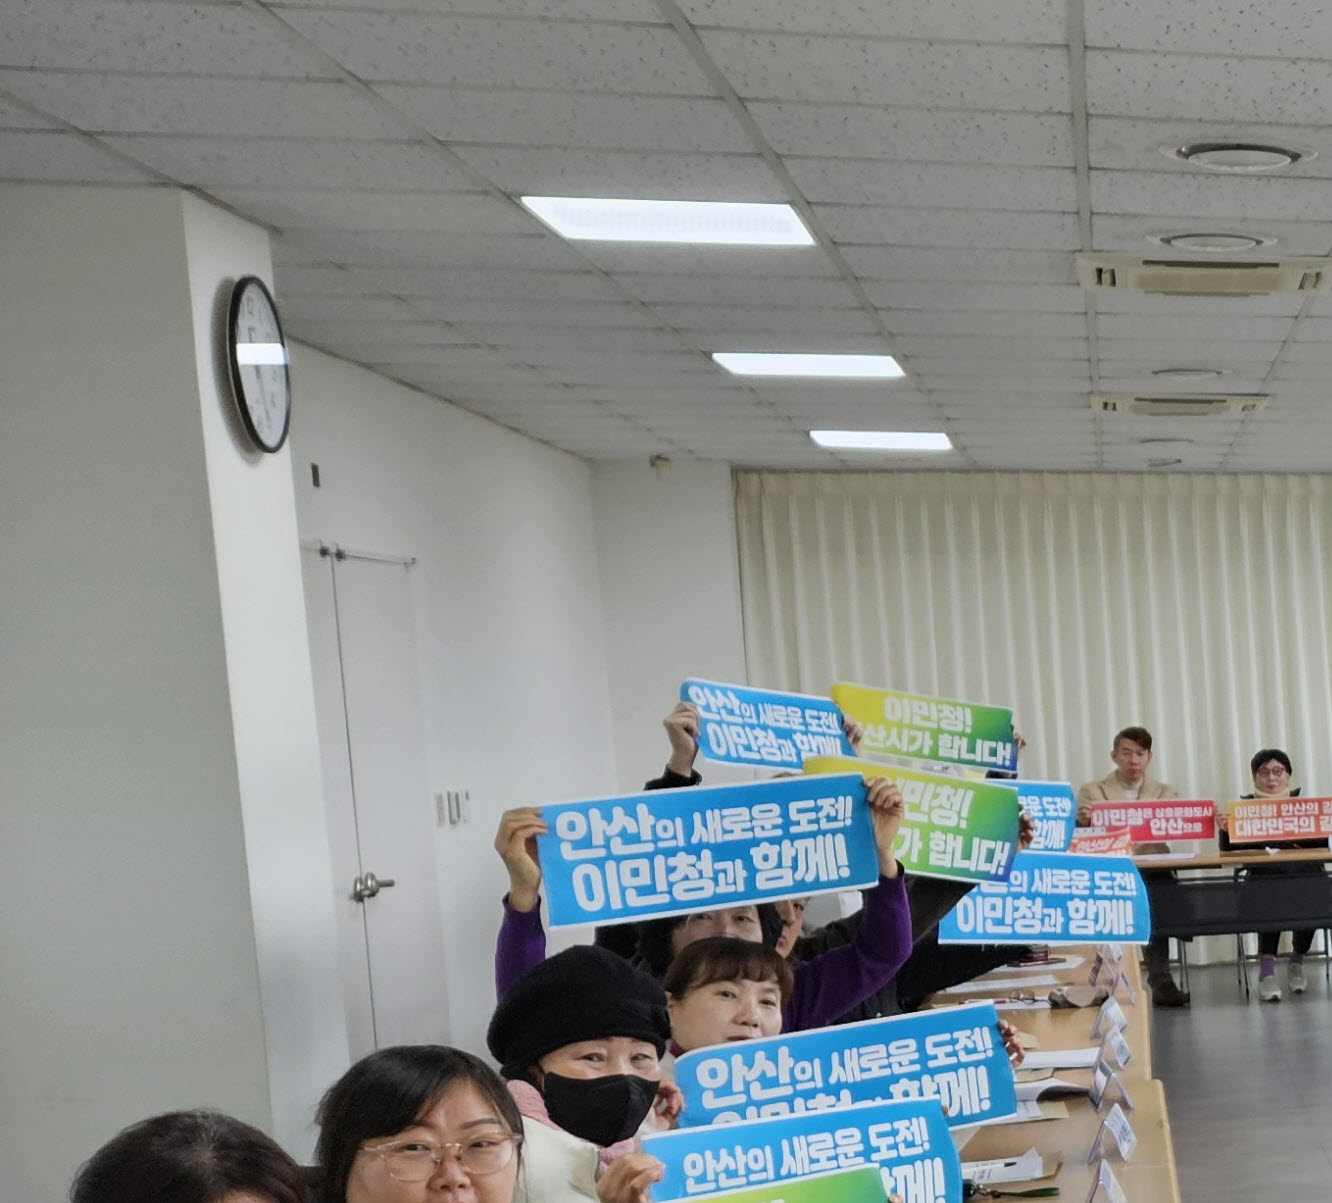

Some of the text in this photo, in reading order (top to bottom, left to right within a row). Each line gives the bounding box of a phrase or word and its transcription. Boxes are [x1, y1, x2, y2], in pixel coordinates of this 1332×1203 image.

[688, 686, 755, 725] 안산의
[758, 703, 804, 729] 새로운
[884, 696, 973, 733] 이민청!
[706, 722, 795, 763] 이민청과
[860, 722, 1012, 767] 산시가 합니다!
[899, 778, 975, 829] 민청!
[1042, 796, 1071, 817] 도전!
[1234, 803, 1277, 819] 이민청!
[1281, 802, 1319, 817] 안산의
[556, 796, 853, 860] 안산의 새로운 도전!
[1235, 816, 1316, 837] 대한민국의
[571, 849, 747, 912] 이민청과
[750, 833, 851, 890] 함께!
[928, 831, 1011, 875] 합니다!
[1031, 869, 1091, 895] 새로운
[1094, 870, 1137, 896] 도전!
[956, 896, 1135, 936] 이민청과 함께!
[696, 1045, 825, 1110] 안산의
[828, 1037, 921, 1086] 새로운
[925, 1026, 993, 1069] 도전!
[683, 1116, 931, 1195] 안산의 새로운 도전!
